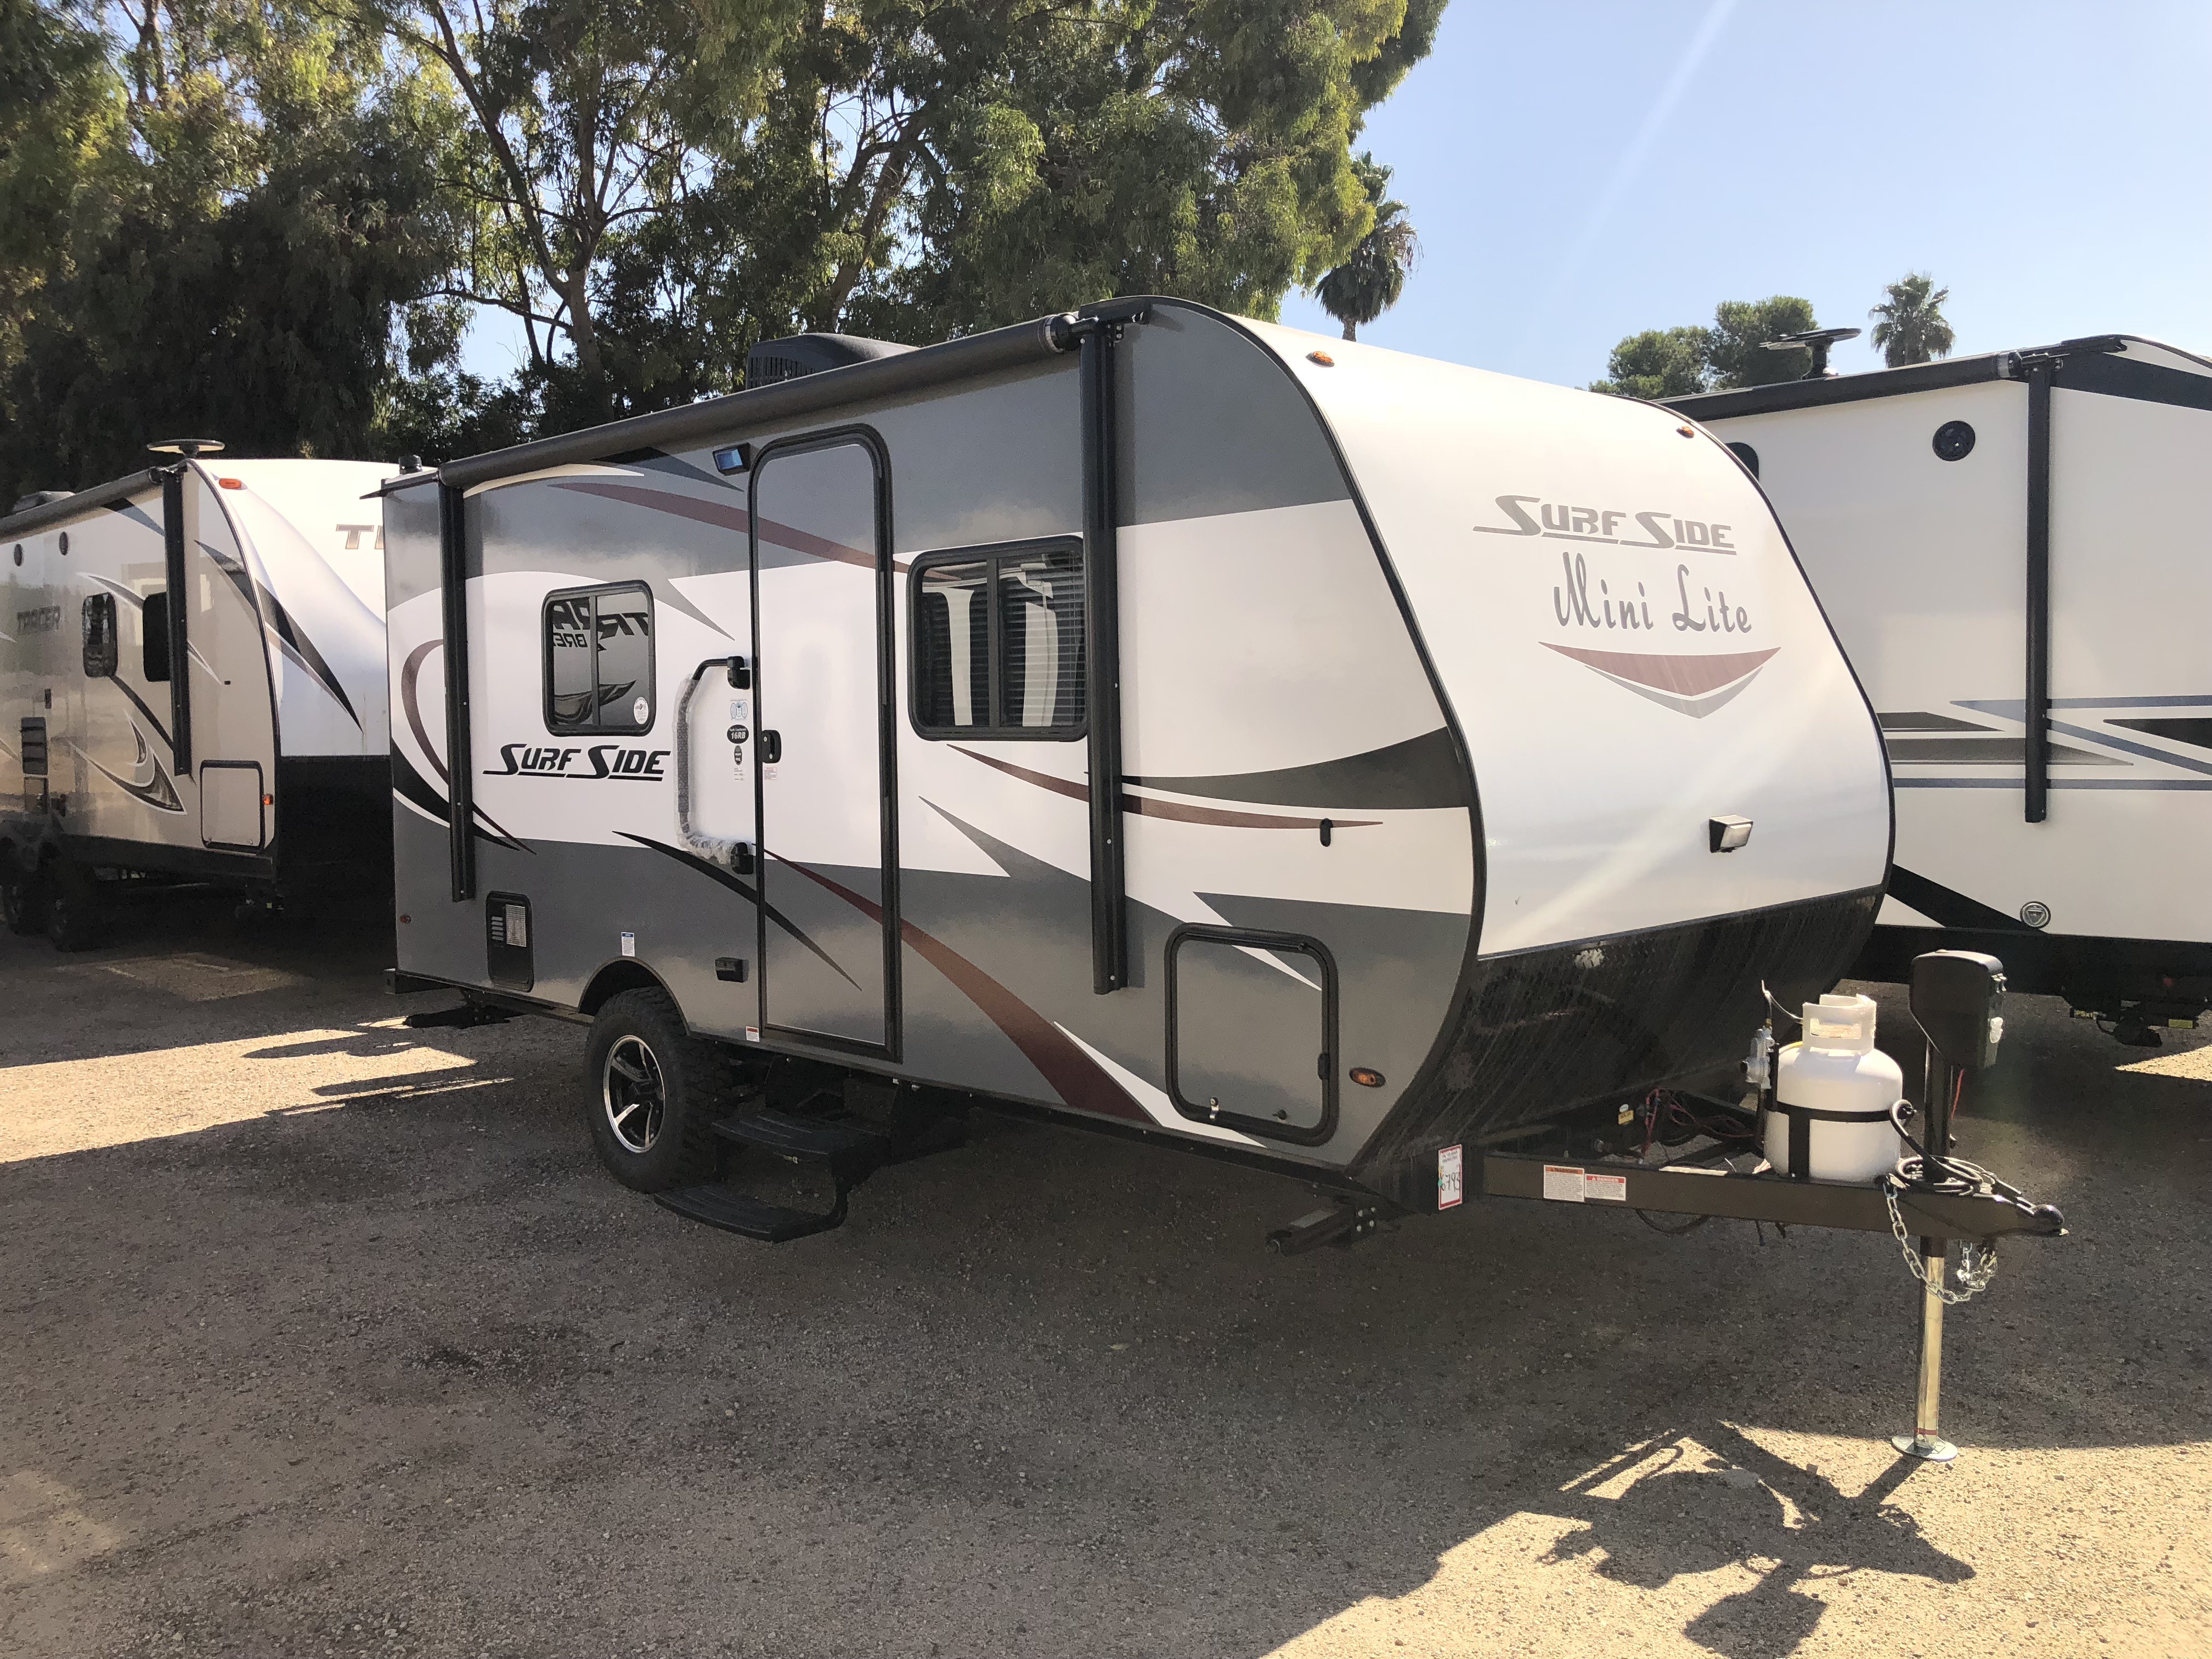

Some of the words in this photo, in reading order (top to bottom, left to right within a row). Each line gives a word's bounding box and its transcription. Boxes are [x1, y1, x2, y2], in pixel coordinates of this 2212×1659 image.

[1472, 495, 1626, 544] SURF
[1620, 511, 1737, 555] SIDE
[1553, 551, 1654, 630] Mini
[1672, 563, 1752, 634] Lite
[731, 731, 746, 740] 16RB
[482, 743, 582, 778] SURF
[566, 744, 672, 782] SIDE
